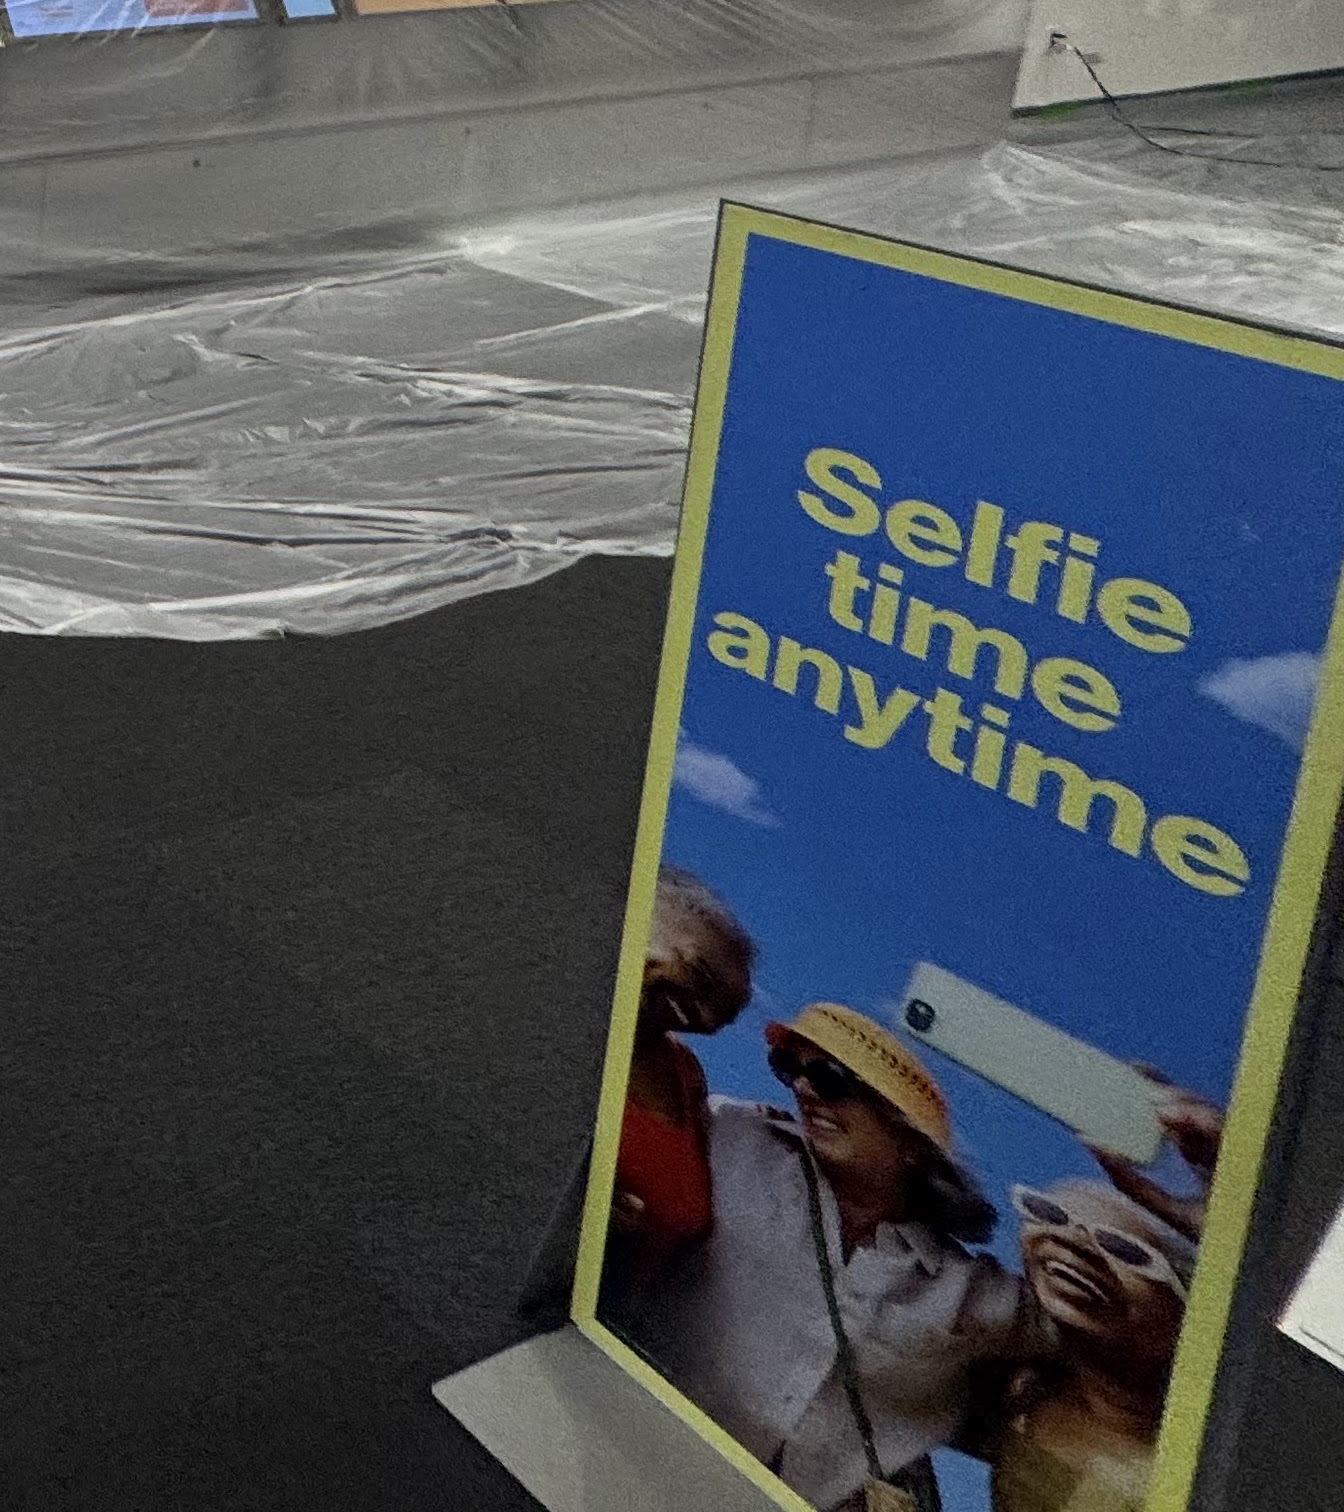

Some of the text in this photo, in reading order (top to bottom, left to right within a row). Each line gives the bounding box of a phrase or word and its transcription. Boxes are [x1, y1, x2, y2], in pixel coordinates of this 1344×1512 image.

[798, 447, 1193, 654] Selfie
[824, 549, 1122, 733] time
[707, 610, 1252, 897] anytime
